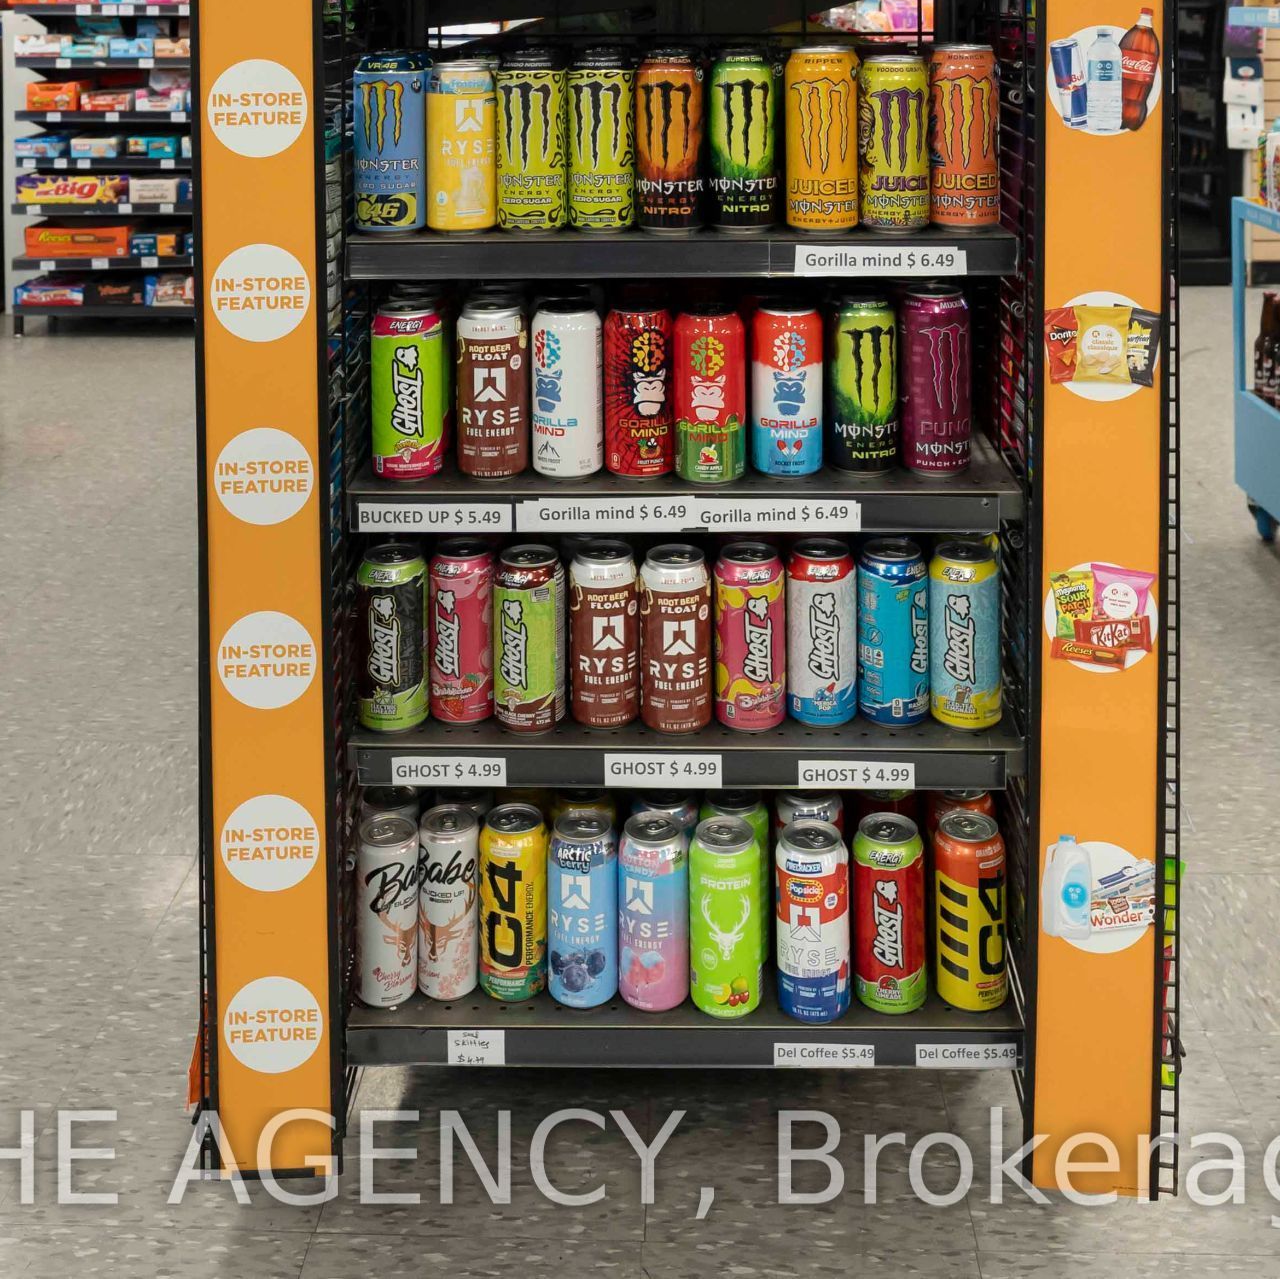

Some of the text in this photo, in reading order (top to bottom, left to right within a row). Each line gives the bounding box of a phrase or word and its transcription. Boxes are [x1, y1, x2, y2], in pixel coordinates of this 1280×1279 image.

[212, 93, 303, 108] IN-STORE
[213, 111, 301, 126] FEATURE
[635, 176, 704, 195] MONSTER
[709, 177, 777, 192] MONSTER
[790, 178, 857, 195] JUICED
[643, 204, 696, 216] NITRO
[723, 204, 770, 213] NITRO
[805, 252, 955, 269] Gorilla mind $ 6.49
[215, 277, 305, 292] IN-STORE
[217, 296, 304, 311] FEATURE
[472, 352, 509, 362] FLOAT
[463, 406, 522, 426] RYSE
[760, 417, 818, 429] GORILLA
[534, 426, 565, 437] MIND
[630, 425, 668, 438] MIND
[770, 428, 809, 438] MIND
[219, 460, 309, 476] IN-STORE
[221, 479, 308, 494] FEATURE
[360, 509, 501, 525] BUCKED UP $ 5.49
[539, 505, 687, 522] Gorilla mind $ 6.49
[700, 505, 849, 524] Gorilla mind $ 6.49
[1060, 593, 1088, 605] SOUR
[1061, 601, 1091, 614] PATCH
[368, 613, 401, 687] GHOST
[434, 607, 461, 679] GHOST
[742, 608, 773, 683] GHOST
[808, 605, 840, 681] GHOST
[943, 603, 976, 685] GHOST
[222, 644, 312, 660] IN-STORE
[499, 620, 528, 690] GHOST
[579, 650, 636, 674] RYSE
[649, 657, 707, 679] RYSE
[224, 663, 310, 678] FEATURE
[396, 763, 501, 779] GHOST $ 4.99
[610, 760, 717, 777] GHOST $ 4.99
[802, 768, 910, 783] GHOST $ 4.99
[225, 827, 315, 843] IN-STORE
[227, 846, 313, 861] FEATURE
[560, 859, 591, 874] berry
[786, 862, 822, 873] FIRECRACKER
[700, 877, 751, 891] PROTEIN
[789, 882, 820, 897] Popsicle
[1090, 910, 1143, 927] Wonder
[873, 895, 904, 969] GHOST
[229, 1009, 318, 1024] IN-STORE
[230, 1027, 317, 1043] FEATURE
[778, 1047, 874, 1059] Del Coffee $5.49
[919, 1047, 1016, 1060] Del Coffee $5.49
